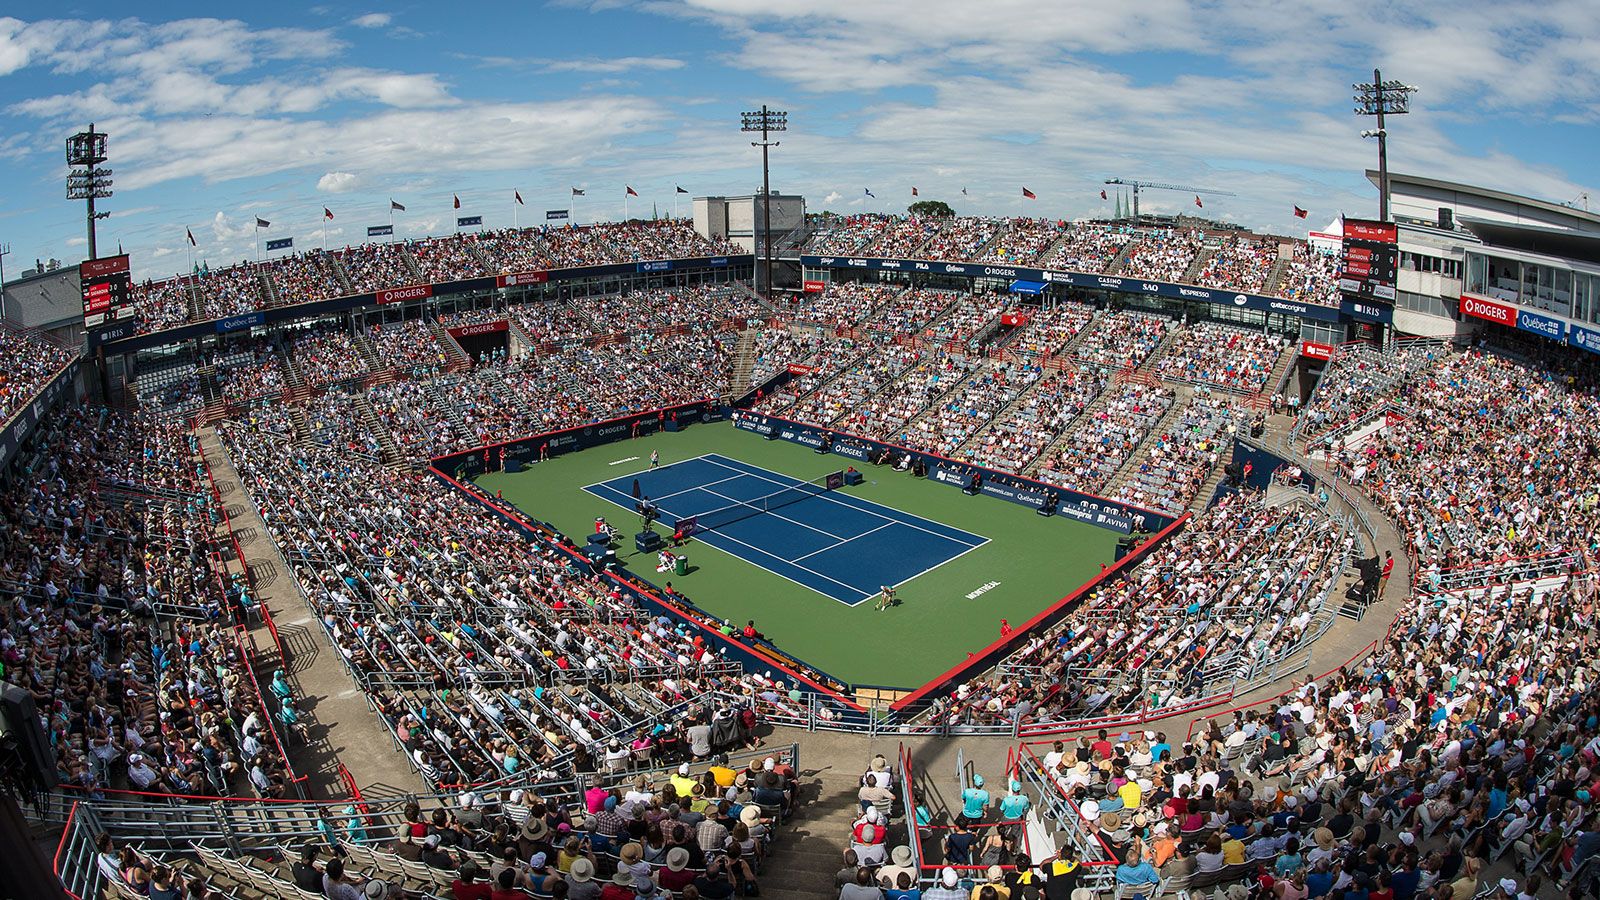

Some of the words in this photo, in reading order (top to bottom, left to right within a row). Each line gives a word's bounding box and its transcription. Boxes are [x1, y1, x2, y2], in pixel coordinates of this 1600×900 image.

[991, 268, 1016, 277] ROGERS
[1098, 277, 1122, 285] CASINO
[394, 287, 426, 300] ROGERS
[1179, 288, 1210, 298] NESPRESSO
[1362, 306, 1380, 316] IRIS
[1474, 303, 1507, 320] ROGERS
[1522, 315, 1548, 332] Québec
[108, 329, 124, 338] IRIS
[469, 324, 495, 334] ROGERS
[605, 424, 627, 434] ROGERS
[841, 446, 863, 457] ROGERS
[1017, 493, 1035, 504] Québec
[1105, 518, 1128, 529] AVIVA
